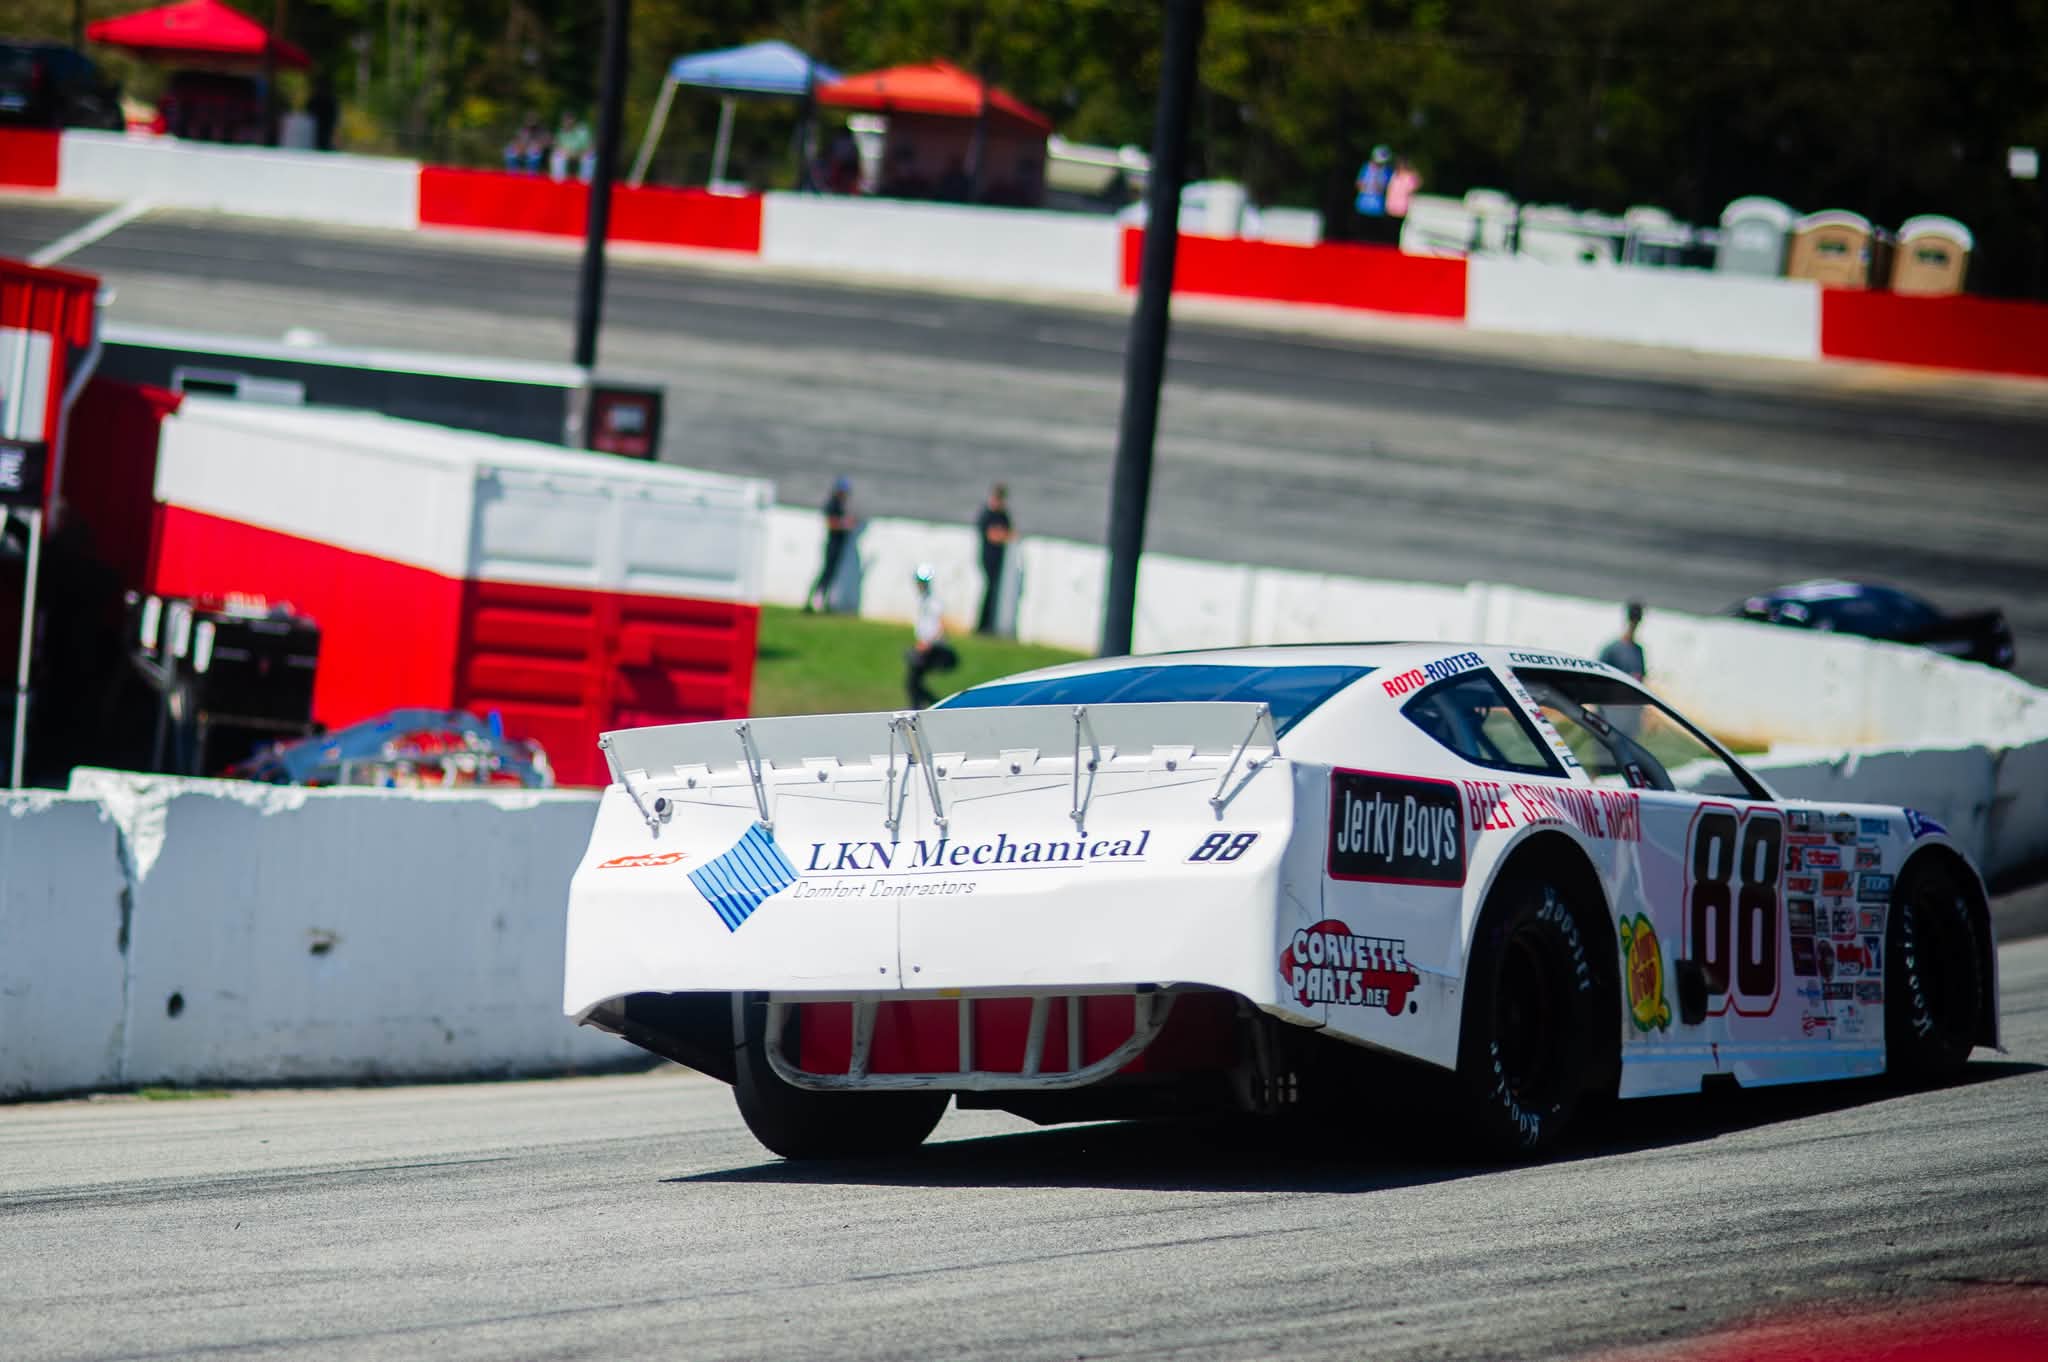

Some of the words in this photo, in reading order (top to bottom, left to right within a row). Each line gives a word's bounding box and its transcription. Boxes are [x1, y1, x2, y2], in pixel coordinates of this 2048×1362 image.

[1382, 651, 1485, 698] ROTO-ROOTER
[1509, 652, 1560, 667] CADEN
[1337, 790, 1399, 863] Jerky
[1403, 795, 1457, 866] Boys
[1462, 779, 1516, 831] BEEF
[1556, 787, 1604, 839] DONE
[804, 841, 901, 871] LKN
[907, 829, 1151, 869] Mechanical
[1187, 831, 1260, 862] 88
[793, 880, 866, 899] Comfort
[869, 879, 977, 897] Contractors
[1690, 811, 1783, 997] 88
[1292, 929, 1409, 973] CORVETTE
